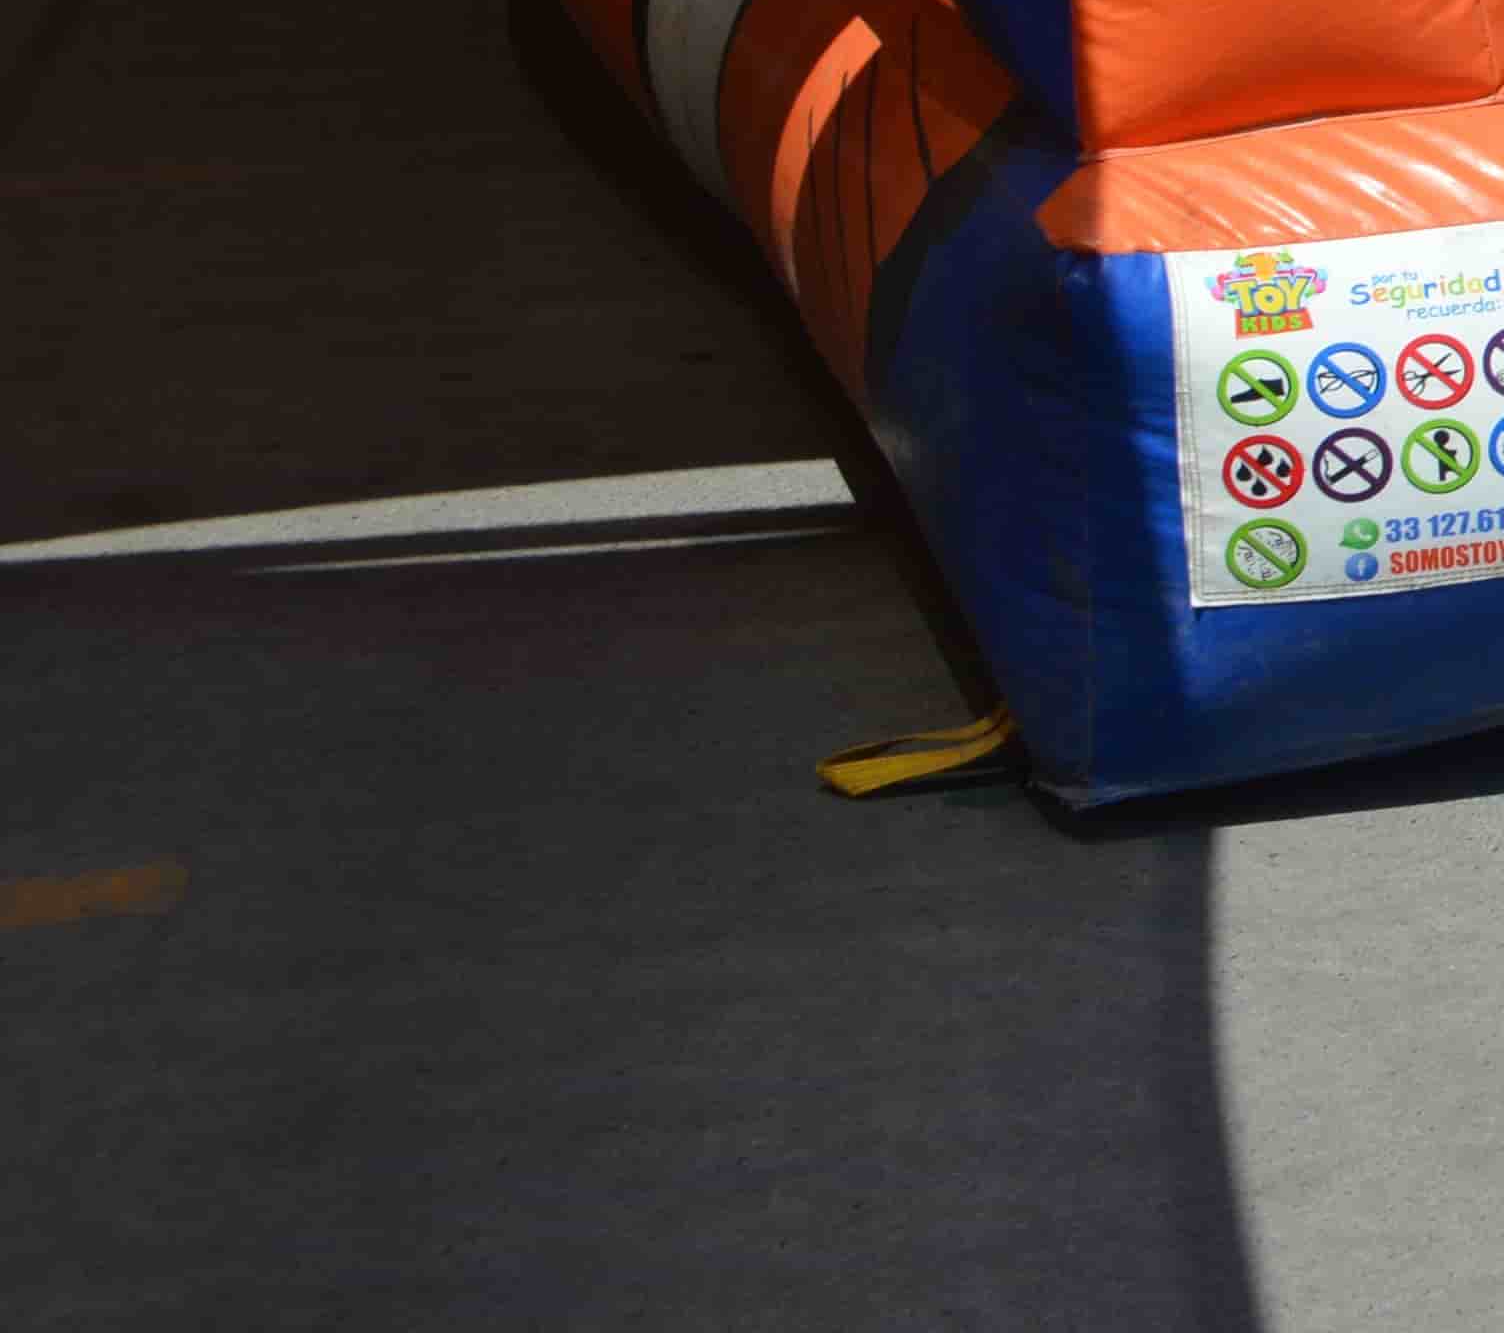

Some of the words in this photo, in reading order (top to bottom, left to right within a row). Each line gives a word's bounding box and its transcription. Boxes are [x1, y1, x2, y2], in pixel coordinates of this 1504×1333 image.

[1350, 269, 1502, 309] Seguridad
[1241, 314, 1304, 332] KIDS
[1385, 516, 1420, 543] 33
